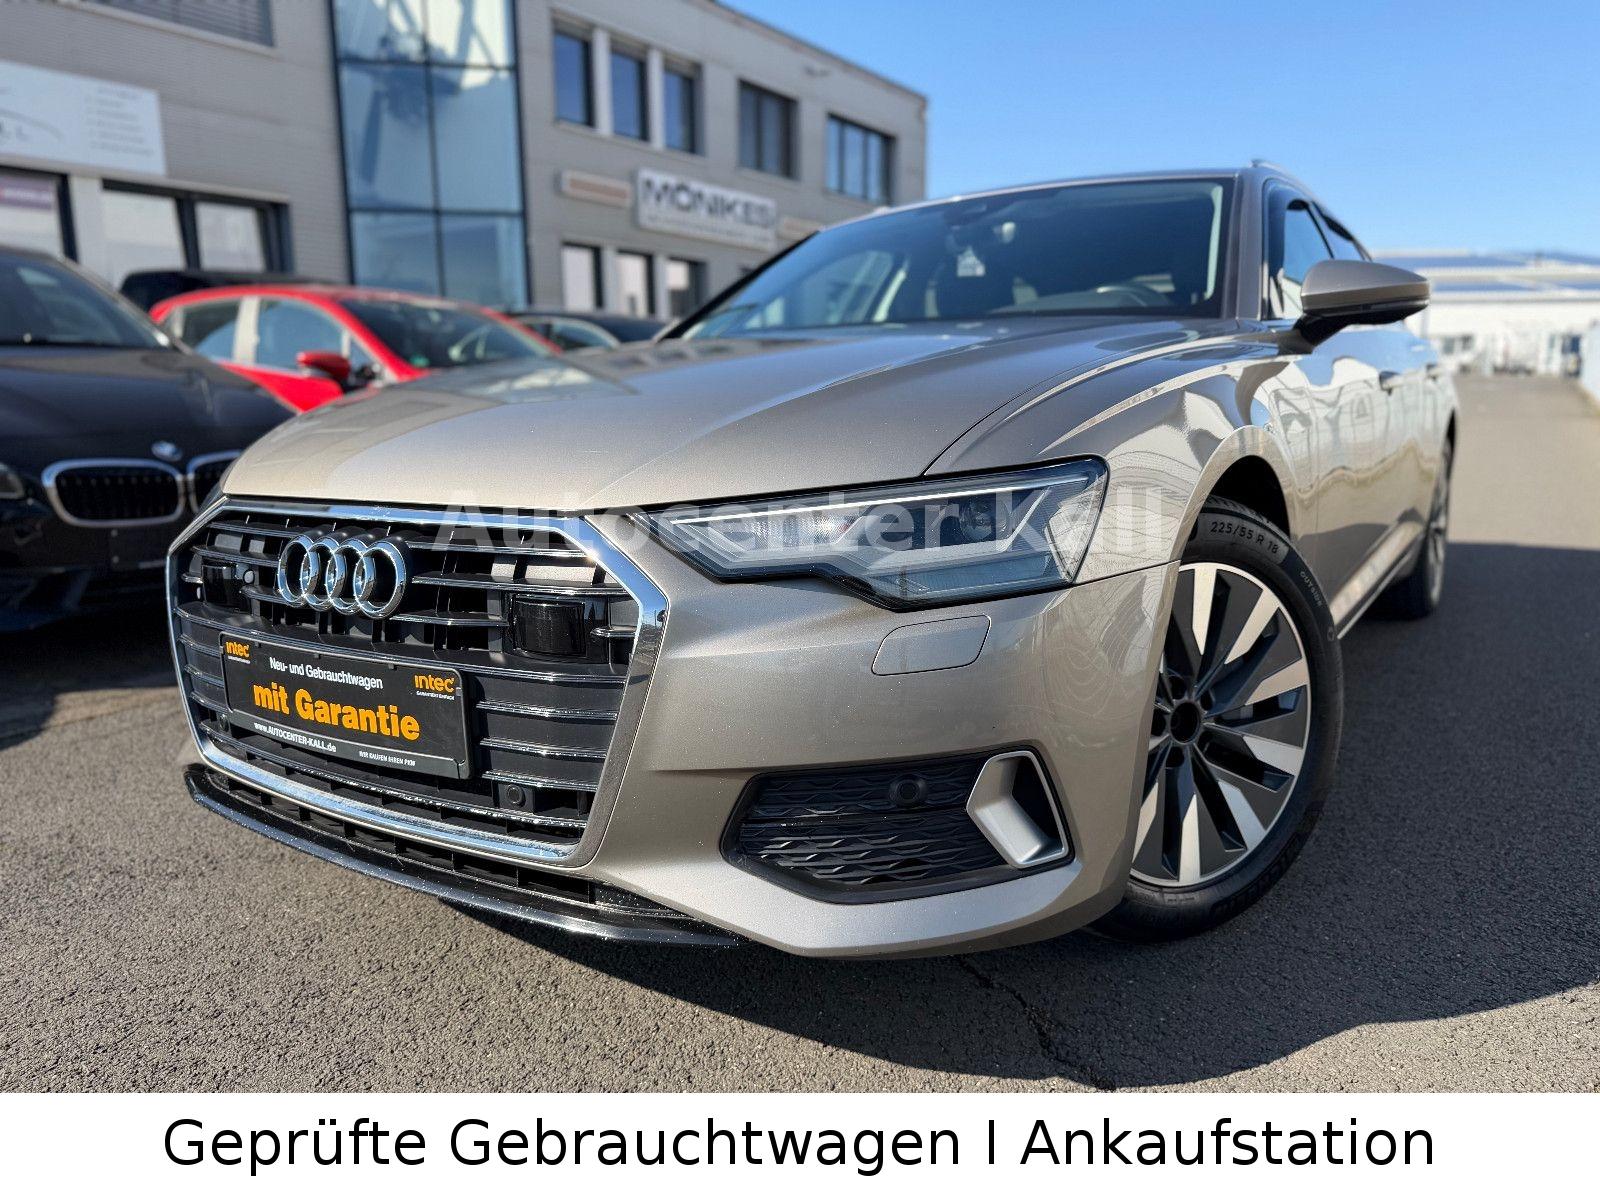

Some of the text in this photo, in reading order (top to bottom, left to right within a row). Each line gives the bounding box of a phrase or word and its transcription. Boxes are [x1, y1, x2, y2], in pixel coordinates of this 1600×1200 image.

[1210, 521, 1279, 554] 225/55 R 18
[269, 657, 383, 690] Neu- und Gebrauchtwagen
[253, 682, 421, 742] mit Garantie
[253, 721, 337, 753] www.AUTOCENTER-KALL.de
